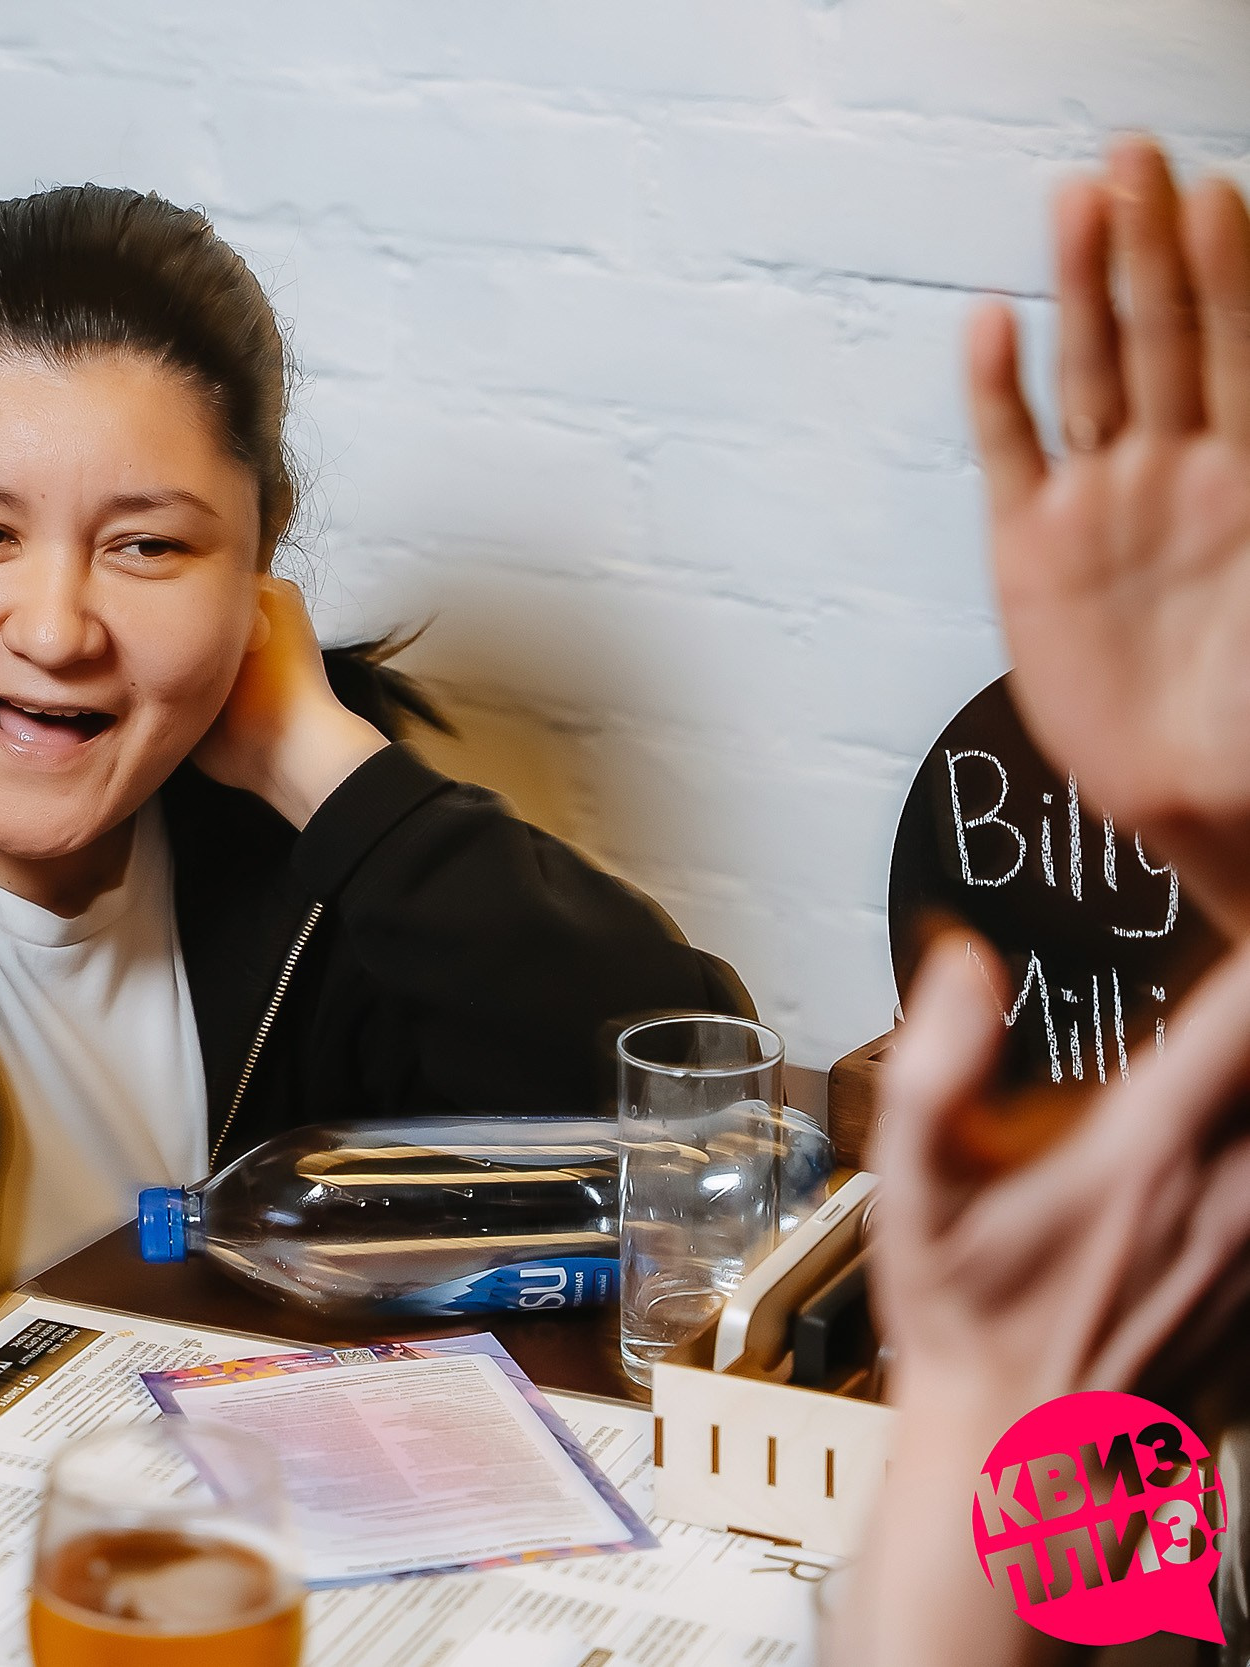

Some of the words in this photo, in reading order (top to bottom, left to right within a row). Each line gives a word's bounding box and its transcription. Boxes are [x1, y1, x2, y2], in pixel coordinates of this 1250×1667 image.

[945, 749, 1180, 938] Billy
[965, 943, 1168, 1085] Milli
[518, 1267, 568, 1311] SU
[20, 1374, 42, 1387] SET
